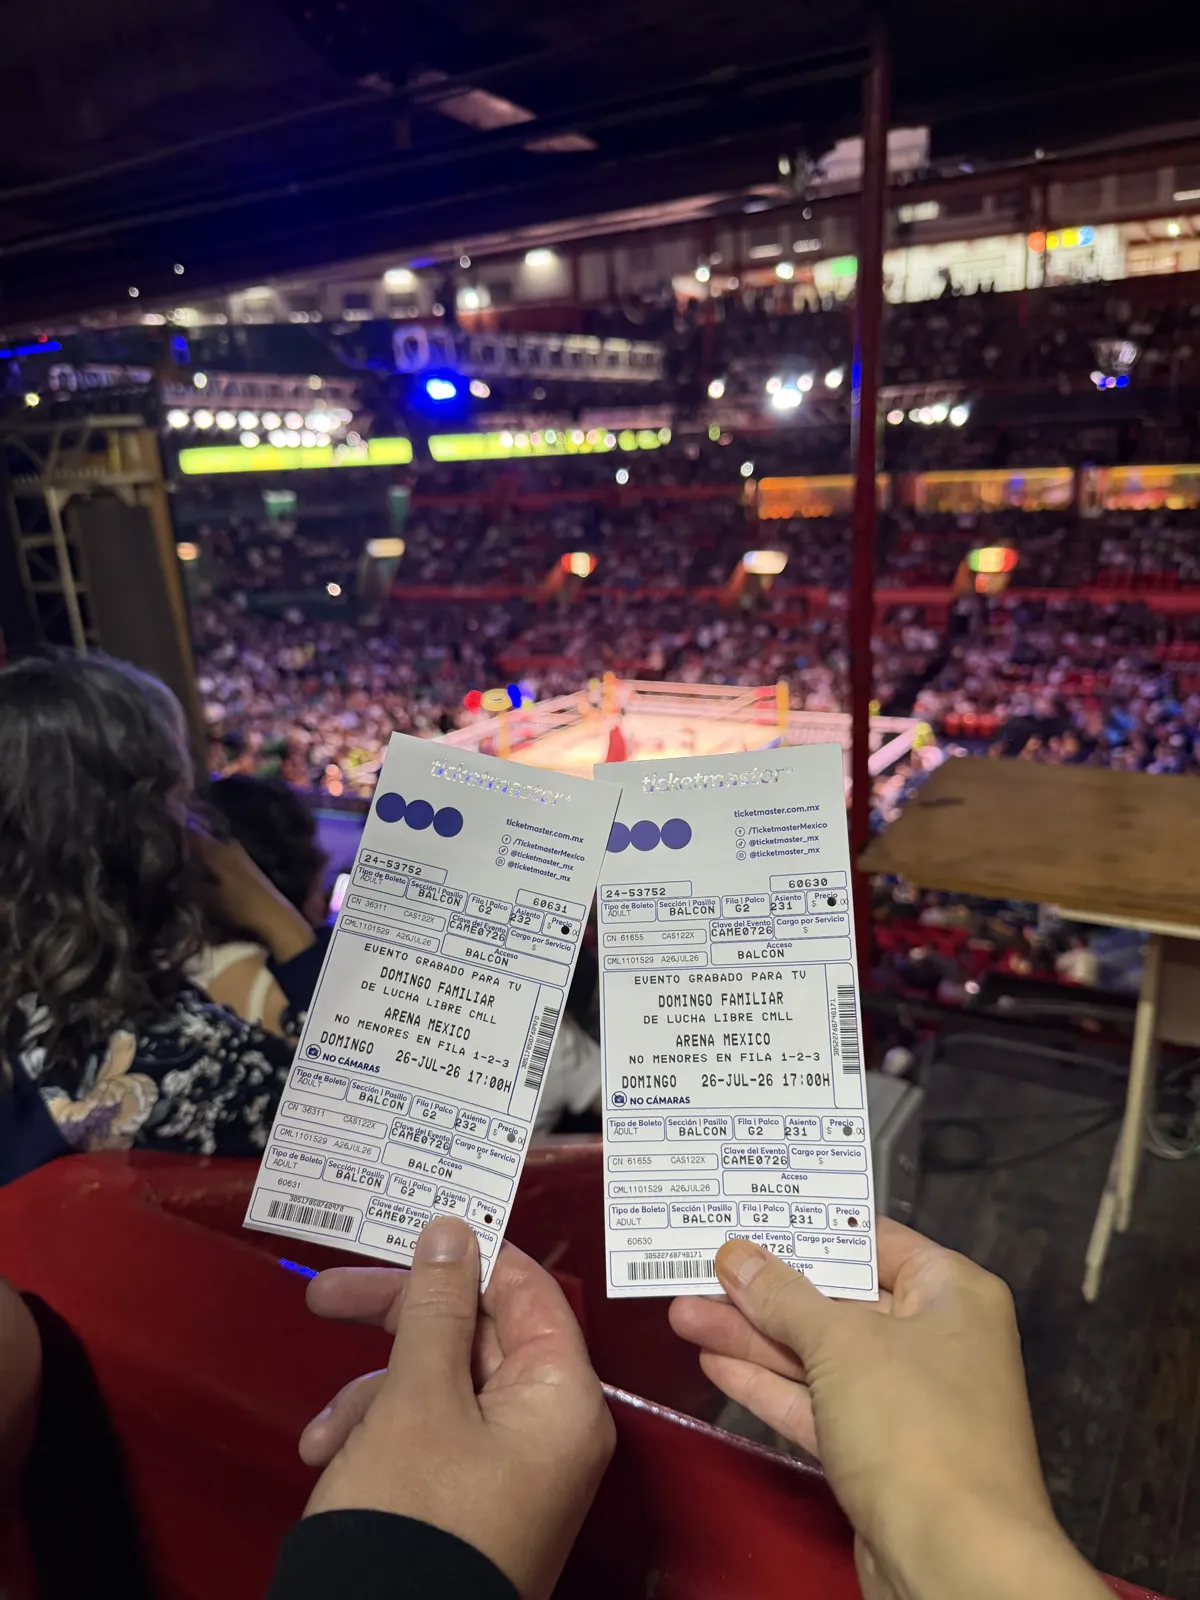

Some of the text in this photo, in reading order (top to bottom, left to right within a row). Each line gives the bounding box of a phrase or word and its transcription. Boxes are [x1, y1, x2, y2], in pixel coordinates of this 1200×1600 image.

[734, 804, 820, 818] ticketmaster.com.mx
[506, 818, 584, 843] ticketmaster.com.mx
[748, 821, 828, 835] /TicketmasterMexico
[749, 834, 819, 848] @ticketmaster_mx
[512, 837, 585, 862] /TicketmasterMexico
[750, 847, 820, 859] @ticketmaster_mx
[364, 854, 422, 876] 24-53752
[510, 849, 574, 871] @ticketmaster_mx
[358, 867, 373, 876] Tipo
[384, 873, 406, 885] Boleto
[507, 860, 571, 883] @ticketmaster_mx
[359, 873, 383, 885] ADULT
[788, 878, 828, 888] 60630
[410, 880, 464, 899] Sección Pasillo
[606, 887, 666, 898] 24-53752
[417, 888, 461, 906] BALCON
[815, 892, 838, 900] Precio
[351, 896, 387, 911] CN 36311
[471, 896, 508, 911] Fila Palco
[478, 904, 492, 915] G2
[532, 897, 567, 913] 60631
[604, 903, 619, 911] Tipo
[659, 899, 716, 908] Sección Pasillo
[735, 904, 750, 913] G2
[770, 902, 793, 911] 231
[403, 910, 435, 923] CAS122X
[515, 908, 541, 920] Asiento
[669, 906, 715, 916] BALCON
[451, 914, 506, 934] Clave del Evento
[509, 912, 531, 925] 232
[551, 917, 573, 928] Precio
[776, 915, 844, 926] Cargo por Servicio
[344, 918, 390, 936] CML1101529
[449, 920, 506, 942] CAME0726
[712, 921, 732, 929] Clave
[607, 933, 644, 942] CN 61655
[662, 932, 695, 940] CAS122X
[711, 926, 773, 937] CAME0726
[395, 931, 432, 946] A26JUL26
[510, 929, 572, 951] Cargo por Servicio
[767, 941, 792, 949] Acceso
[465, 947, 509, 966] BALCON
[494, 948, 519, 960] Acceso
[607, 956, 654, 964] CML1101529
[661, 955, 699, 963] A26JUL26
[738, 949, 784, 959] BALCON
[363, 942, 522, 992] EVENTO GRABADO PARA TV
[634, 970, 806, 985] EVENTO GRABADO PARA TV
[379, 966, 496, 1008] DOMINGO FAMILIAR
[360, 980, 497, 1024] DE LUCHA LIBRE CMLL
[658, 992, 784, 1008] DOMINGO FAMILIAR
[383, 1006, 471, 1041] ARENA MEXICO
[644, 1012, 793, 1024] DE LUCHA LIBRE CMLL
[334, 1013, 510, 1068] NO MENORES EN FILA 1-2-3
[676, 1033, 771, 1047] ARENA MEXICO
[319, 1030, 512, 1093] DOMINGO 26-JUL-26 17:00H
[322, 1052, 381, 1074] NO CÁMARAS
[629, 1053, 820, 1064] NO MENORES EN FILA 1-2-3
[622, 1073, 830, 1088] DOMINGO 26-JUL-26 17:00H
[358, 1091, 404, 1111] BALCON
[630, 1095, 690, 1105] NO CÁMARAS
[422, 1108, 437, 1120] G2
[342, 1115, 376, 1129] CAS122X
[454, 1117, 477, 1131] 232
[830, 1119, 854, 1127] Precio
[679, 1127, 727, 1136] BALCON
[748, 1127, 764, 1136] G2
[785, 1127, 807, 1136] 231
[391, 1127, 450, 1150] CAME0726
[792, 1148, 861, 1157] Cargo Servicio
[671, 1156, 706, 1164] CAS122X
[723, 1155, 788, 1166] CAME0726
[407, 1158, 453, 1178] BALCON
[277, 1177, 300, 1189] 60631
[335, 1169, 382, 1188] BALCON
[781, 1173, 808, 1181] Acceso
[400, 1186, 415, 1197] G2
[613, 1185, 663, 1193] CML1101529
[670, 1184, 710, 1192] A26JUL26
[752, 1183, 800, 1194] BALCON
[432, 1195, 456, 1209] 232
[794, 1206, 822, 1214] Asiento
[836, 1207, 860, 1216] Precio
[683, 1214, 731, 1223] BALCON
[753, 1214, 769, 1223] G2
[790, 1215, 813, 1224] 231
[627, 1237, 652, 1245] 60630
[766, 1233, 791, 1241] Evento
[797, 1234, 866, 1246] Cargo Servicio
